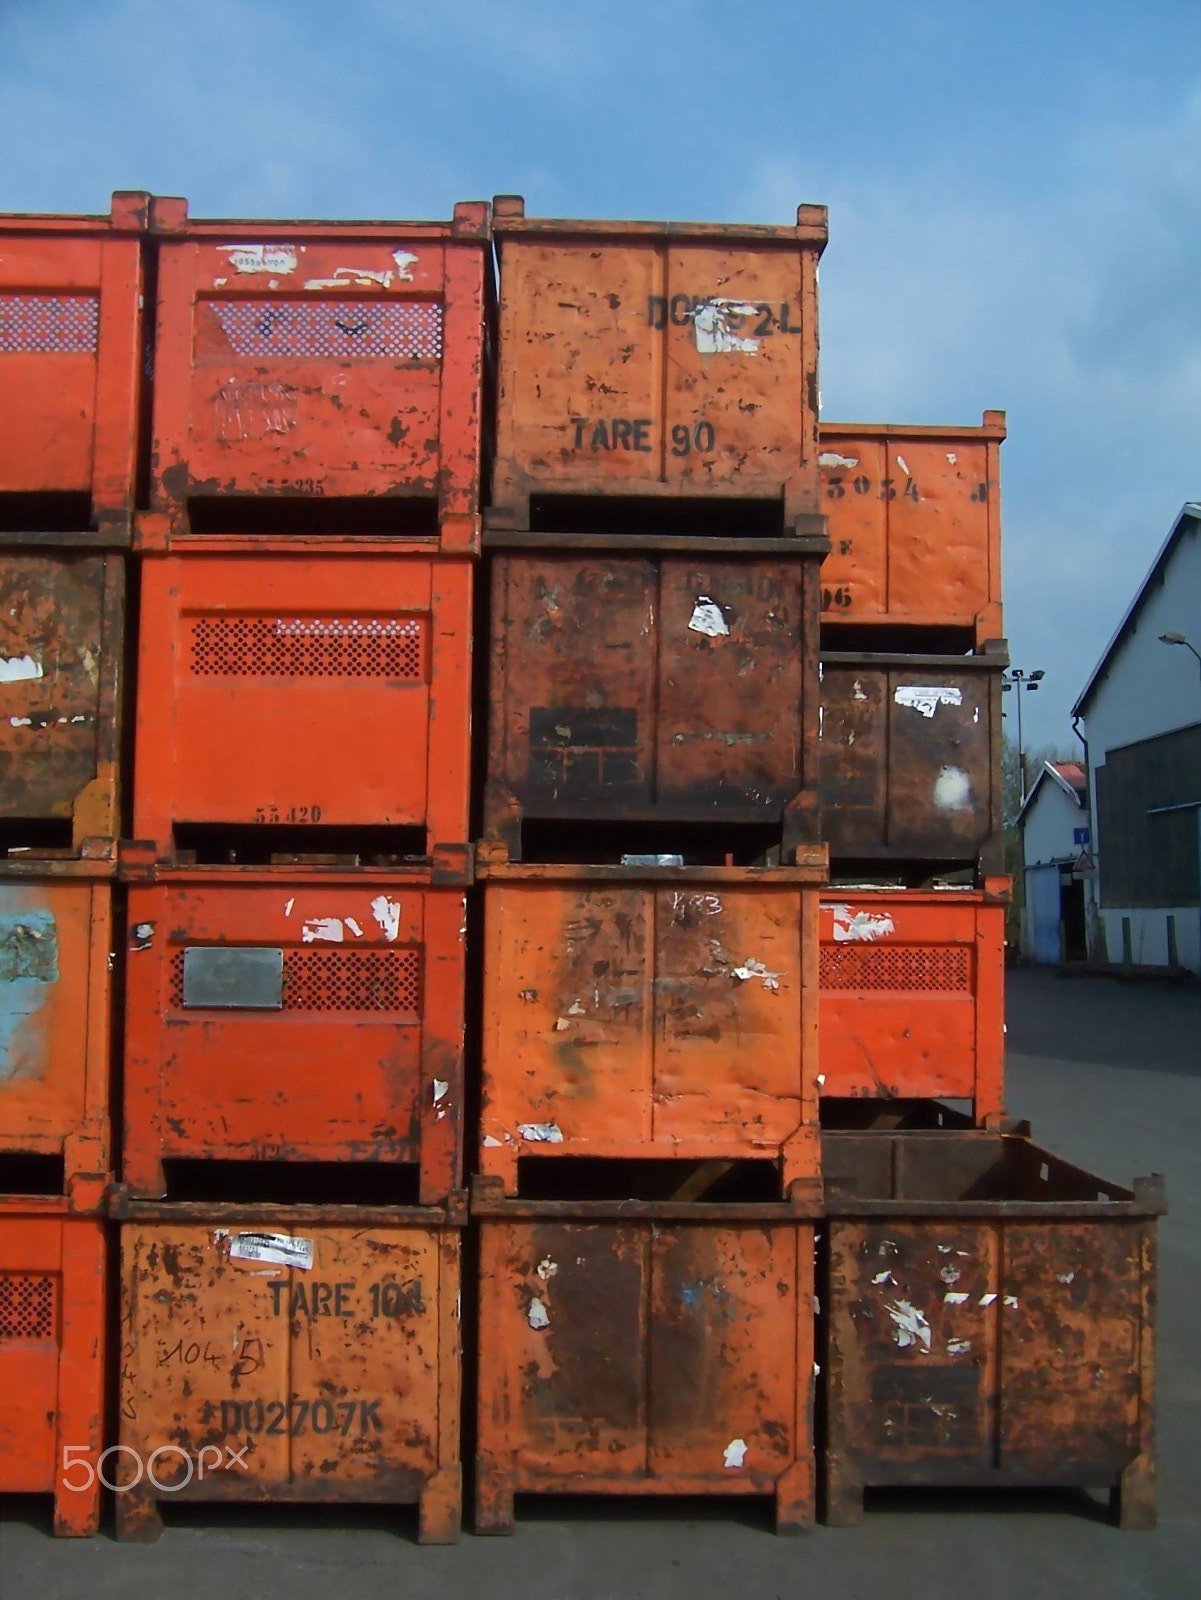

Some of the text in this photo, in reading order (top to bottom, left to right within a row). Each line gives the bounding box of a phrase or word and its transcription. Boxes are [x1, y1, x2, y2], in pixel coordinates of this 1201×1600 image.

[570, 417, 715, 457] TARE 90
[267, 1280, 356, 1317] TARE
